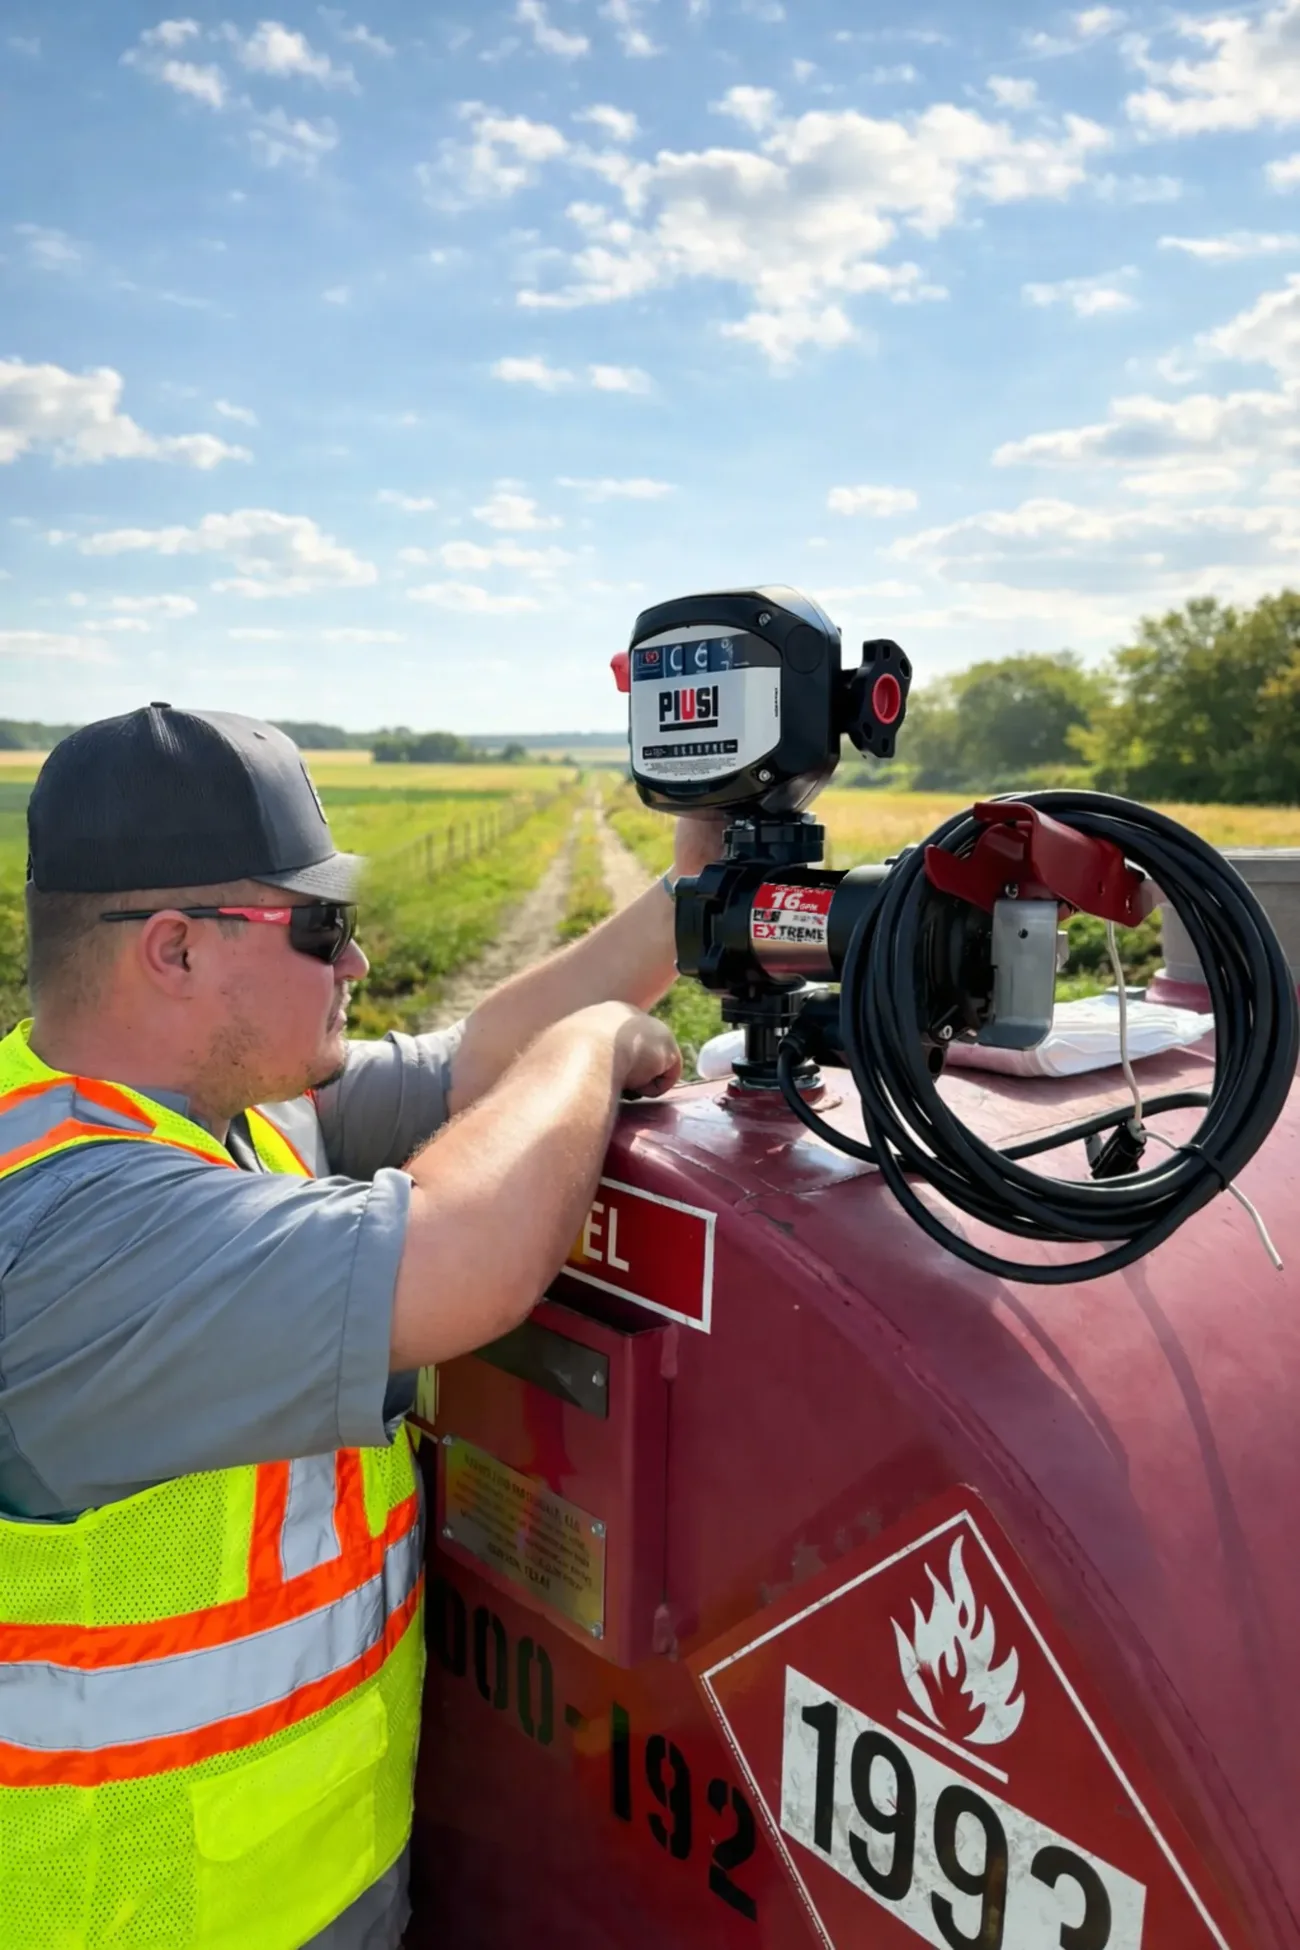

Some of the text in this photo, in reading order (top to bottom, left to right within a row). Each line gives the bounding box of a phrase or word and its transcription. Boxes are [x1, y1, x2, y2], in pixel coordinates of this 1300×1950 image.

[659, 685, 719, 722] PIUSI
[771, 891, 804, 910] 16
[753, 923, 825, 940] EXTREME
[582, 1200, 630, 1273] EL
[801, 1700, 1112, 1950] 1993
